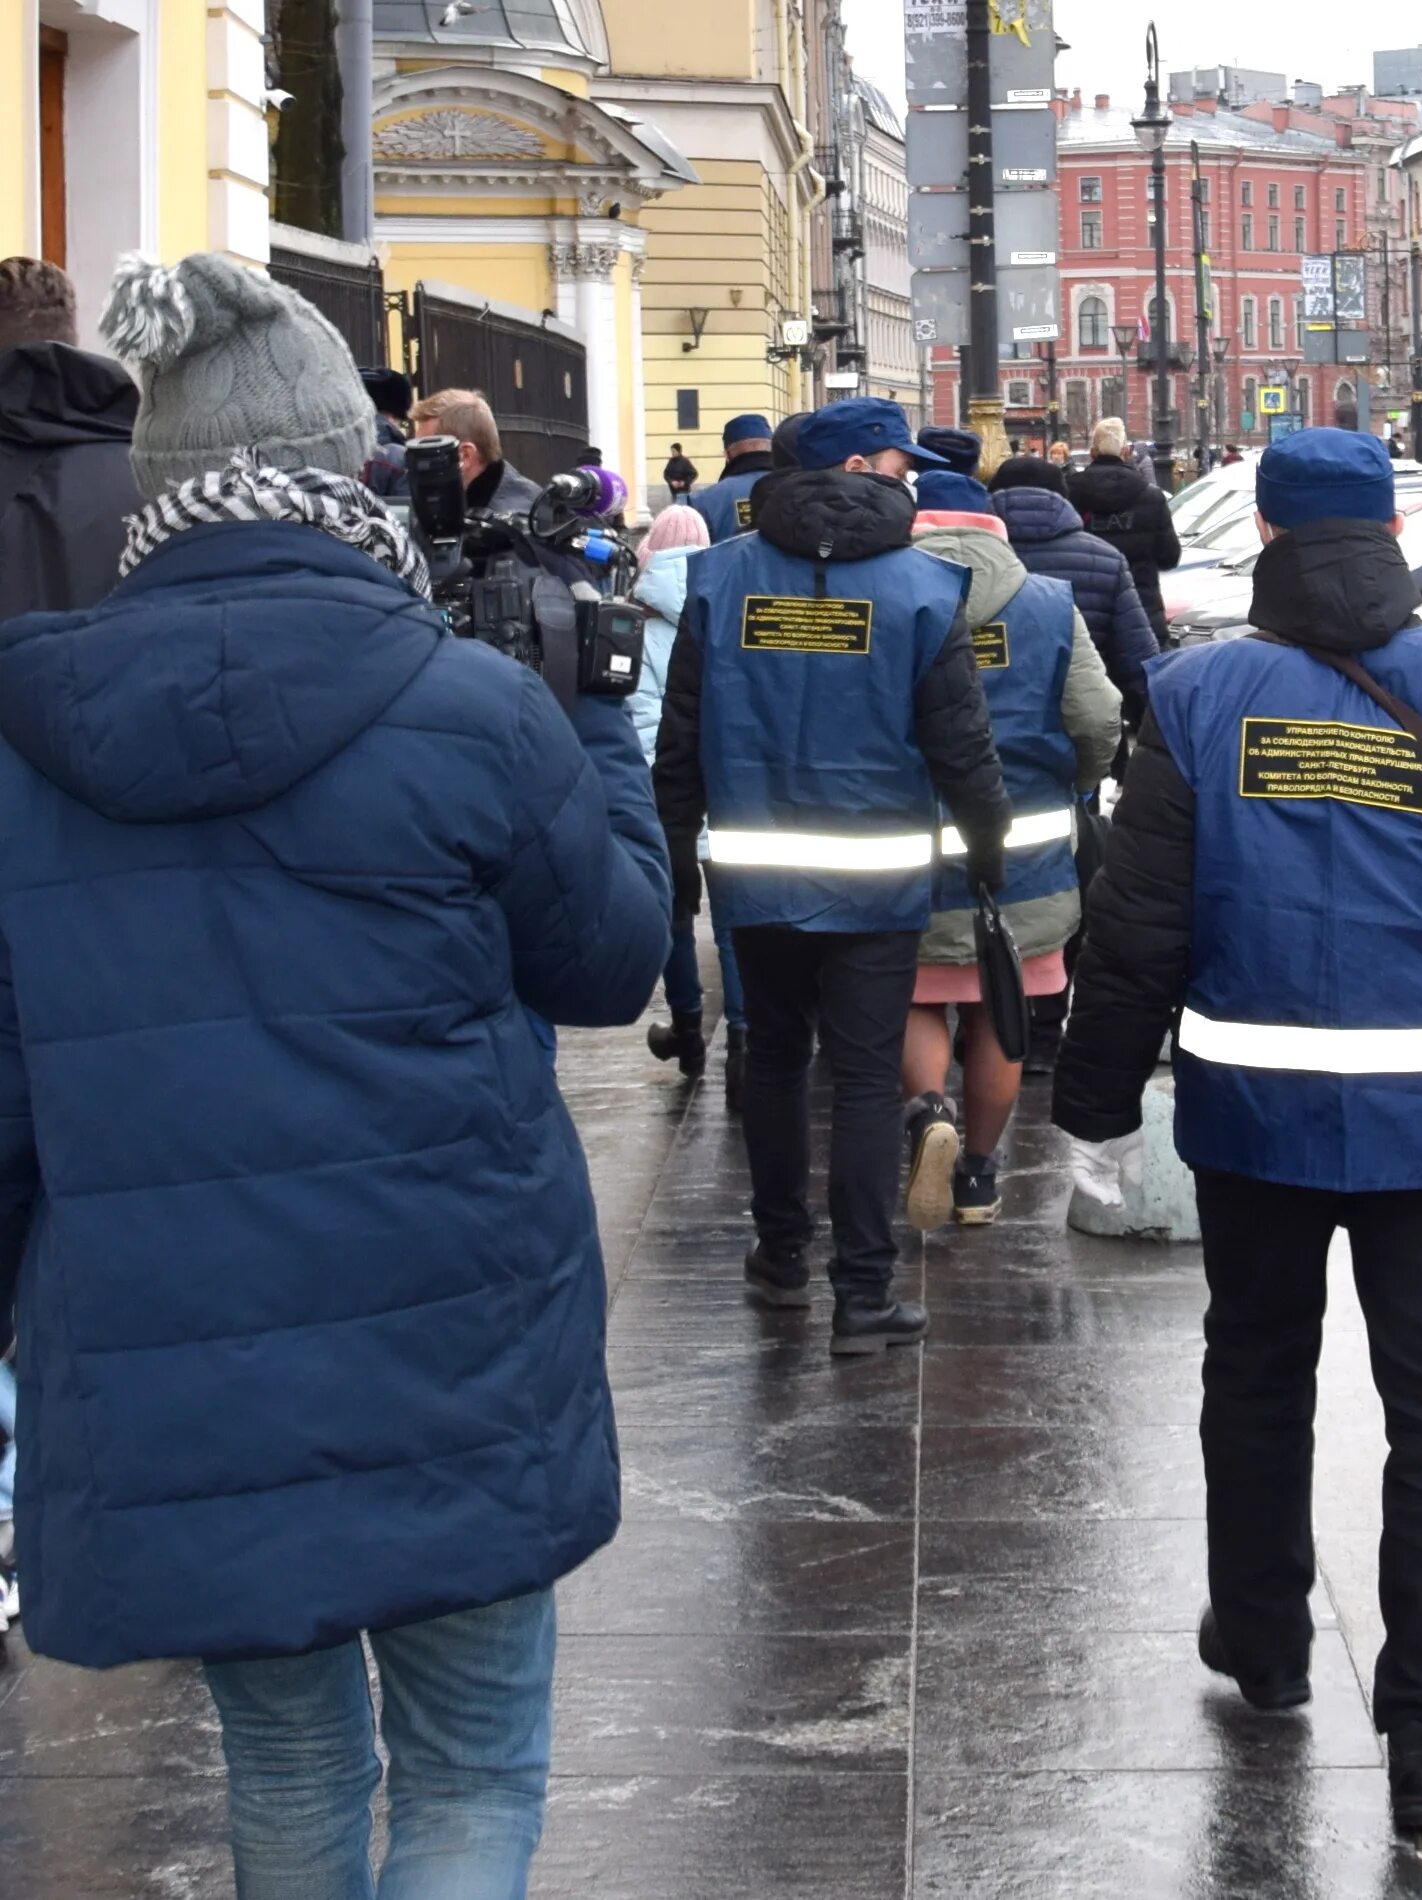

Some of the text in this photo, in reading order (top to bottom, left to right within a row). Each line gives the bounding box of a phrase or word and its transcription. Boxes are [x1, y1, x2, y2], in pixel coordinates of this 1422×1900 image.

[1286, 726, 1395, 744] УПРАВЛЕНИЕ ПО КОНТРОЛЮ
[1248, 748, 1259, 756] ОБ
[1261, 748, 1347, 759] АДМИНИСТРАТИВНЫХ
[1273, 737, 1334, 747] СОБЛЮДЕНИЕМ
[1336, 739, 1416, 758] ЗАКОНОДАТЕЛЬСТВА
[1298, 761, 1376, 775] САНКТ-ПЕТЕРБУРГА
[1258, 771, 1301, 780] КОМИТЕТА
[1316, 773, 1359, 785] ВОПРОСАМ
[1361, 778, 1414, 794] ЗАКОННОСТИ,
[1267, 783, 1331, 792] ПРАВОПОРЯДКА
[1339, 785, 1400, 803] БЕЗОПАСНОСТИ
